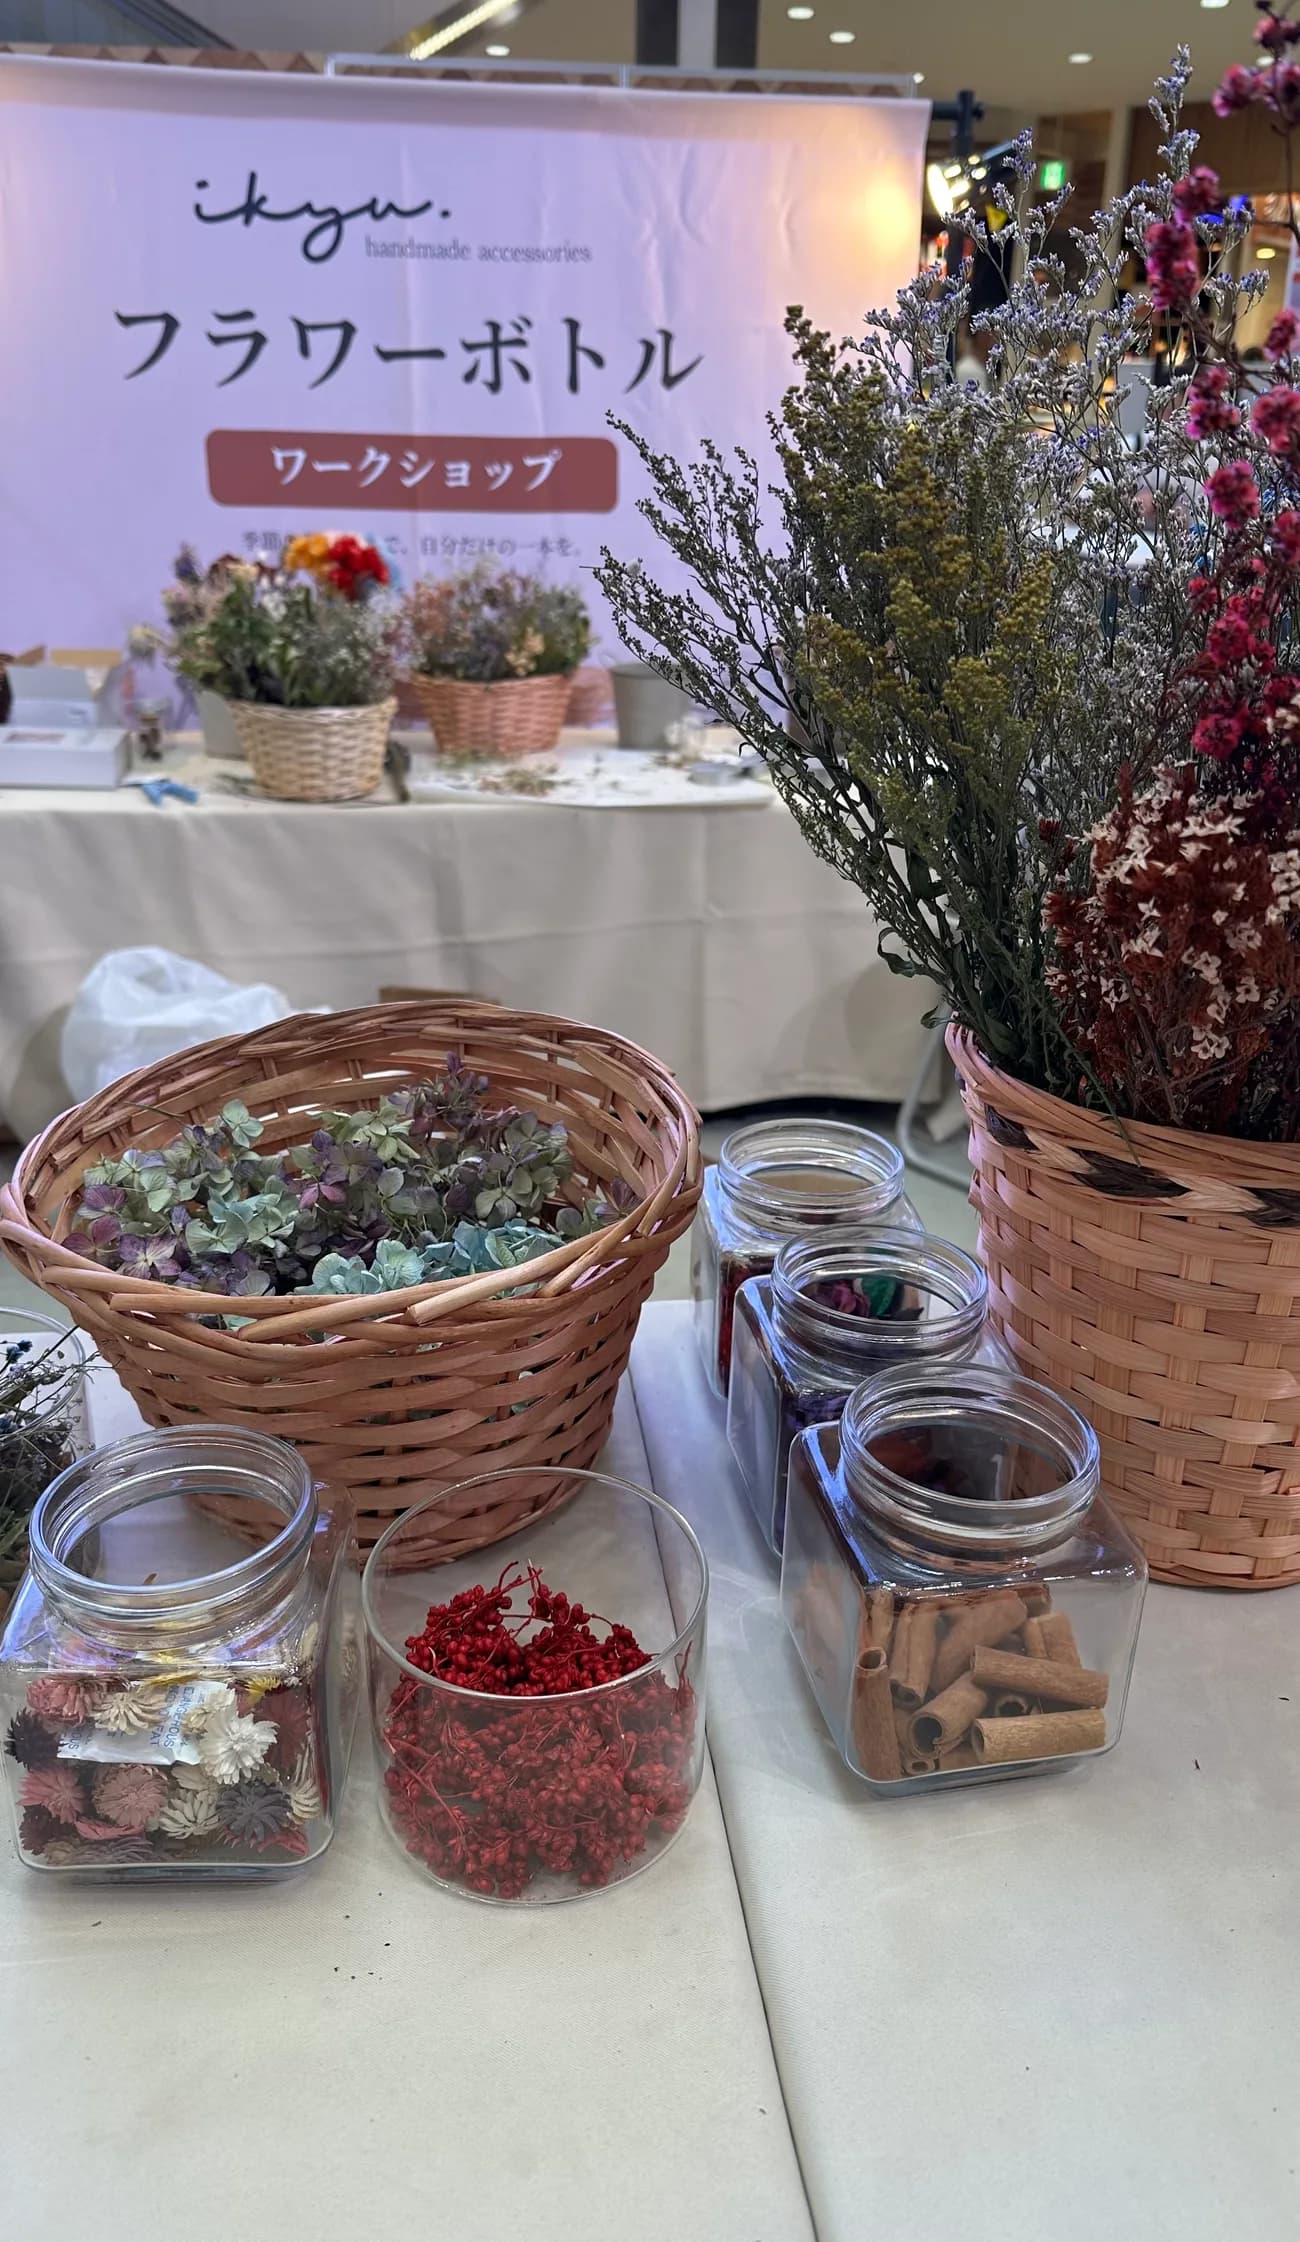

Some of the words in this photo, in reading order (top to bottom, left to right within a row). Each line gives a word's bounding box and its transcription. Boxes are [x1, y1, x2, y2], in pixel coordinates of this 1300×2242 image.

[365, 235, 471, 261] handmade
[478, 239, 593, 264] accessories
[113, 309, 705, 396] フラワーボトル
[271, 446, 563, 492] ワークショップ
